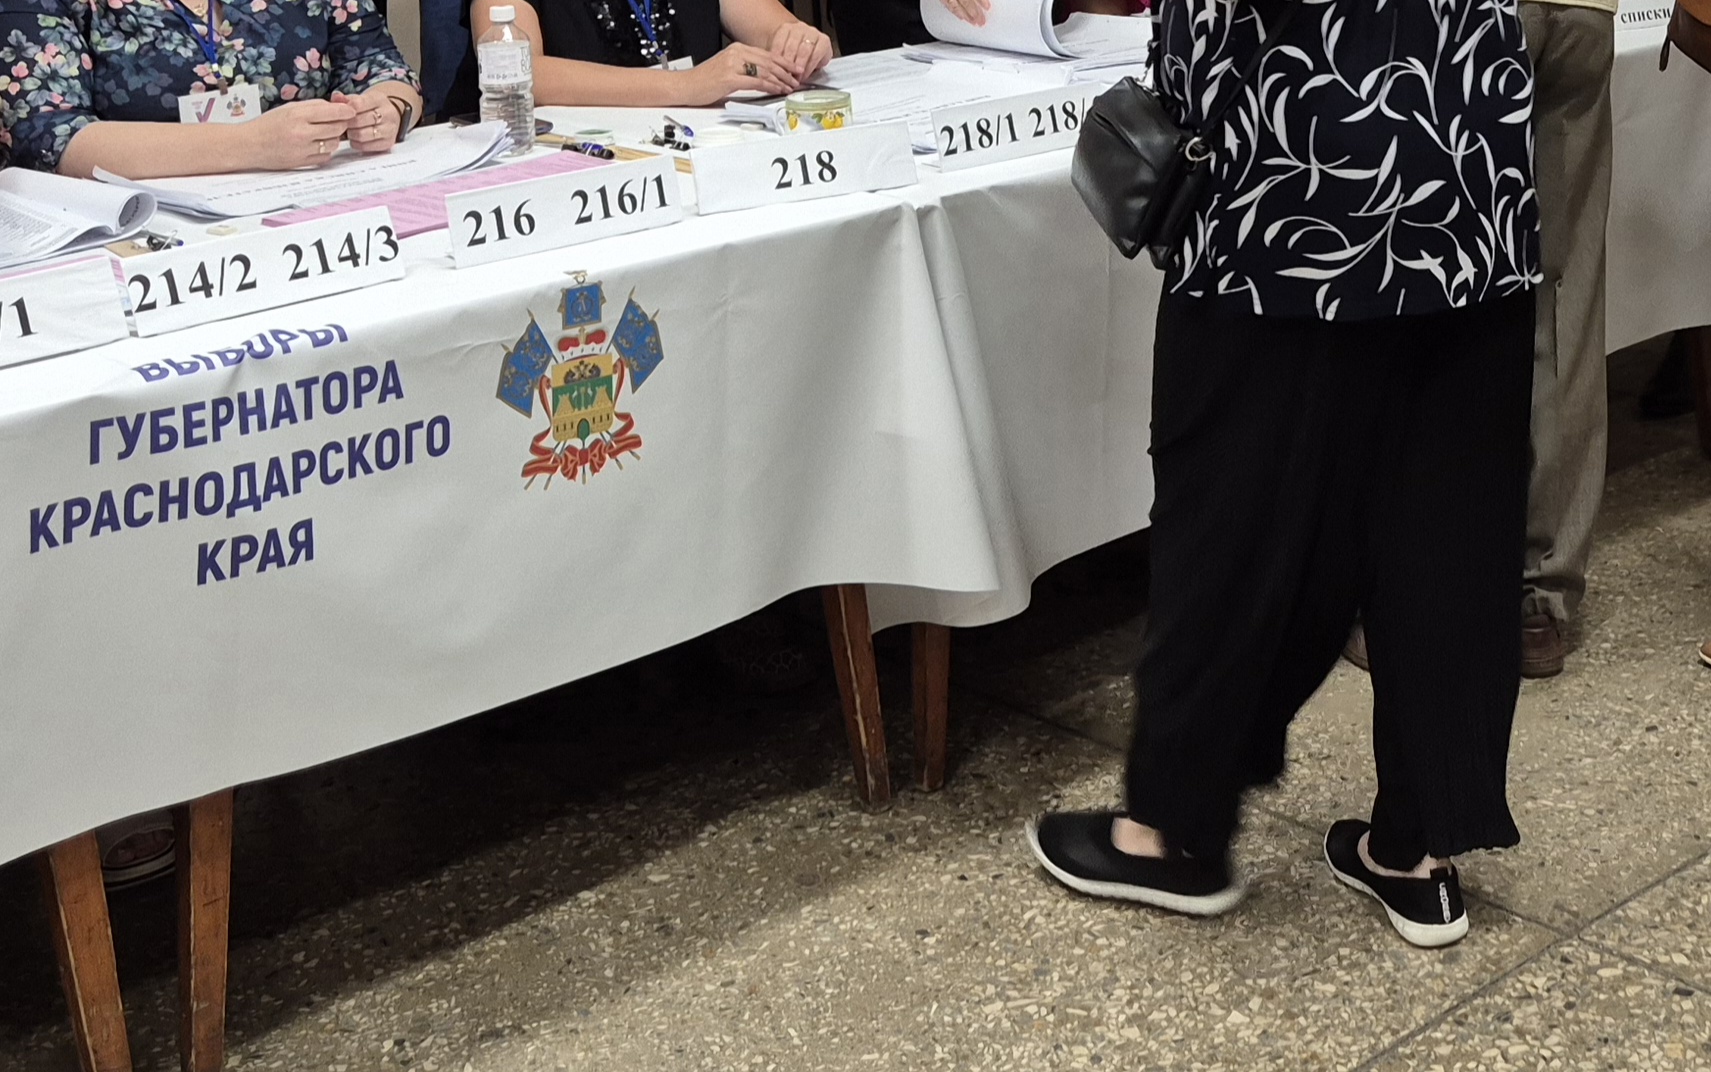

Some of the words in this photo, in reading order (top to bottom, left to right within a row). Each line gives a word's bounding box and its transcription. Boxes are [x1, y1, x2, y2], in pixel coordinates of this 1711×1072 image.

[1621, 7, 1671, 24] списки
[772, 149, 838, 191] 218
[941, 112, 1020, 158] 218/1
[463, 198, 536, 247] 216
[571, 173, 672, 225] 216/1
[129, 251, 258, 313] 214/2
[282, 224, 400, 281] 214/3
[90, 359, 404, 465] ГУБЕРНАТОРА
[29, 414, 451, 554] КРАСНОДАРСКОГО
[195, 518, 316, 587] КРАЯ
